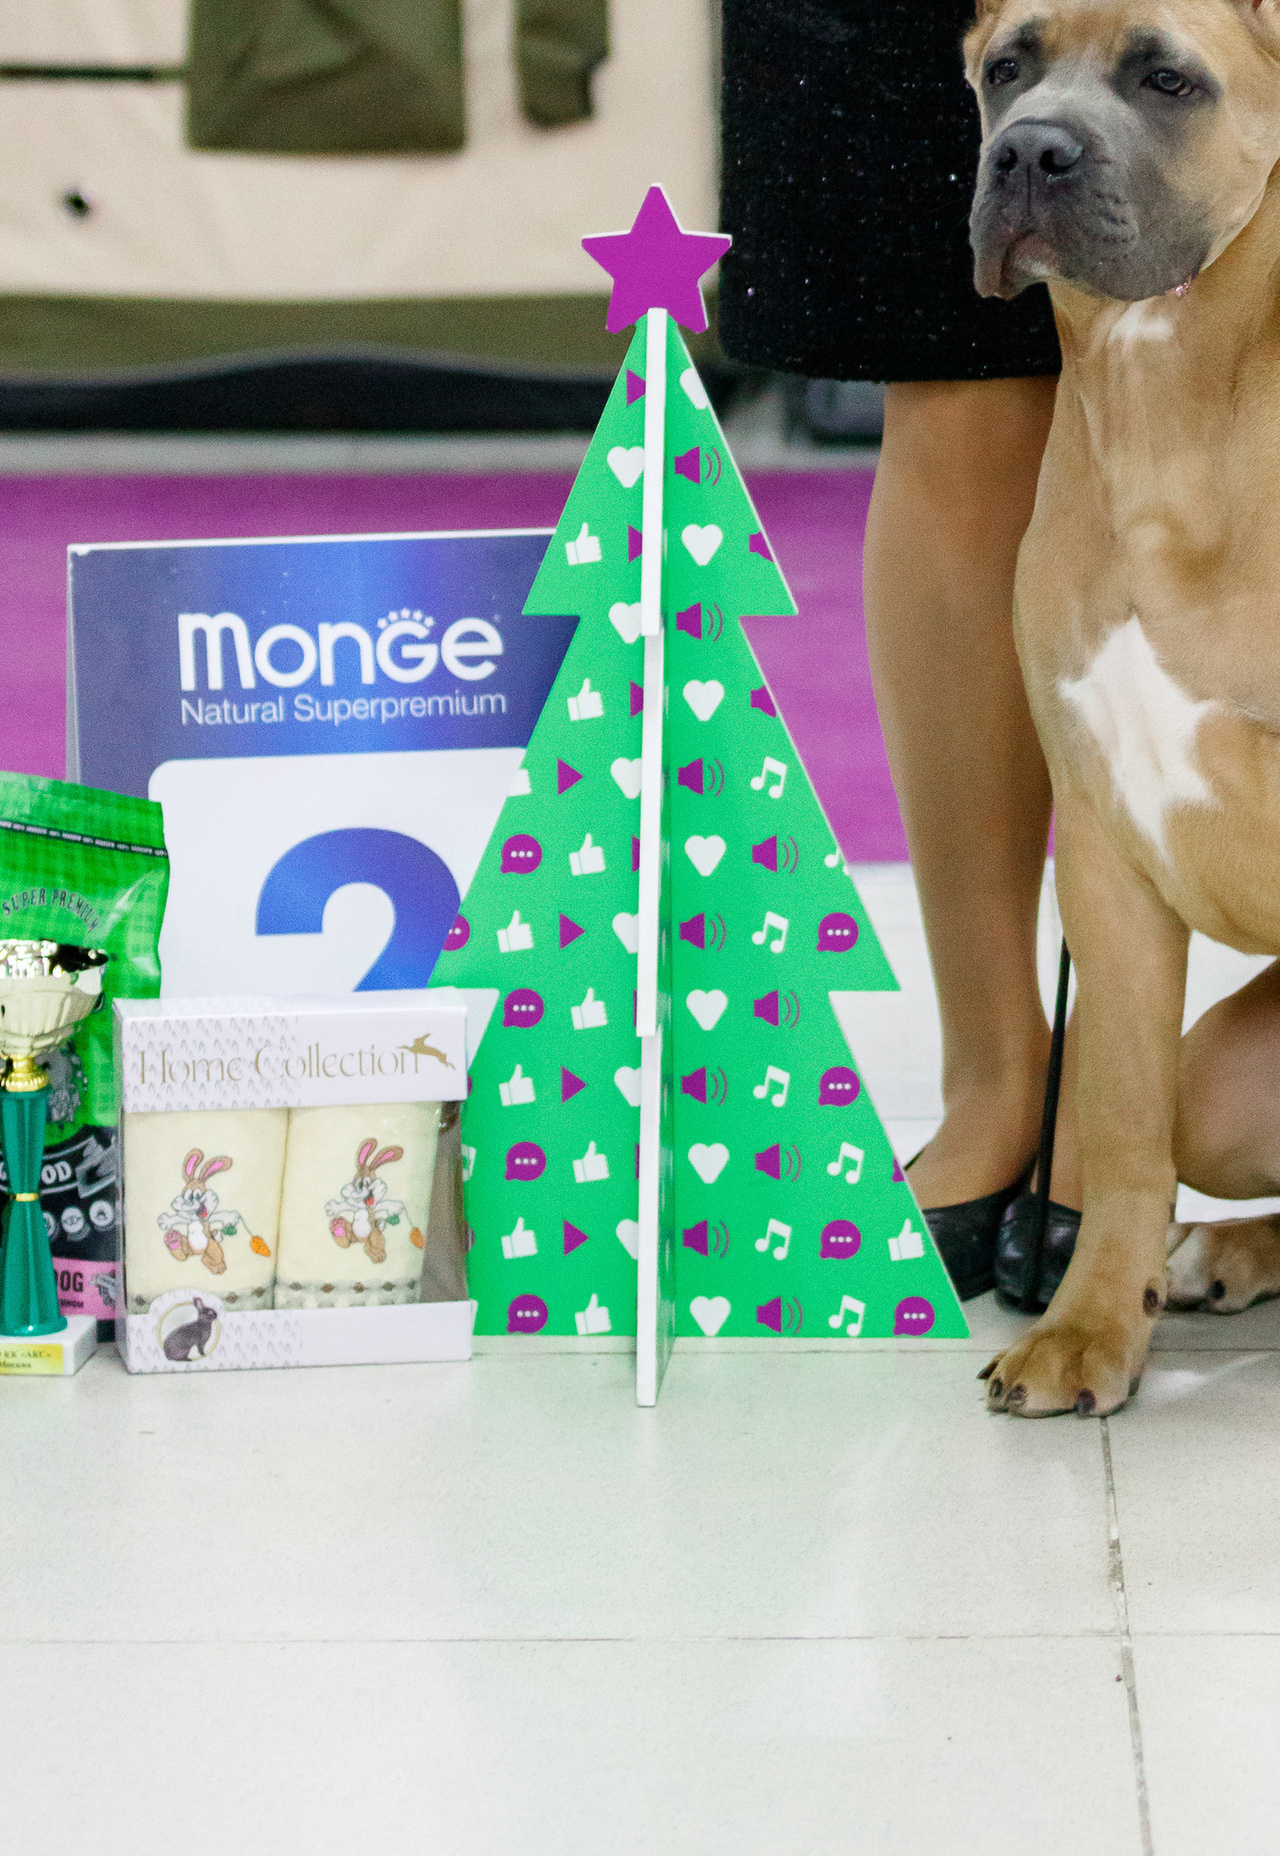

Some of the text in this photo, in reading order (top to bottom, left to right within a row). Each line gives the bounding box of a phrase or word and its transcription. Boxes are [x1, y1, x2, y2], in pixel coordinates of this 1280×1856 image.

[181, 689, 507, 727] Natural Superpremium
[3, 888, 98, 932] SUPER PREMIUM
[255, 827, 461, 992] 2
[139, 1043, 419, 1086] Home Collection
[55, 1270, 83, 1292] OG
